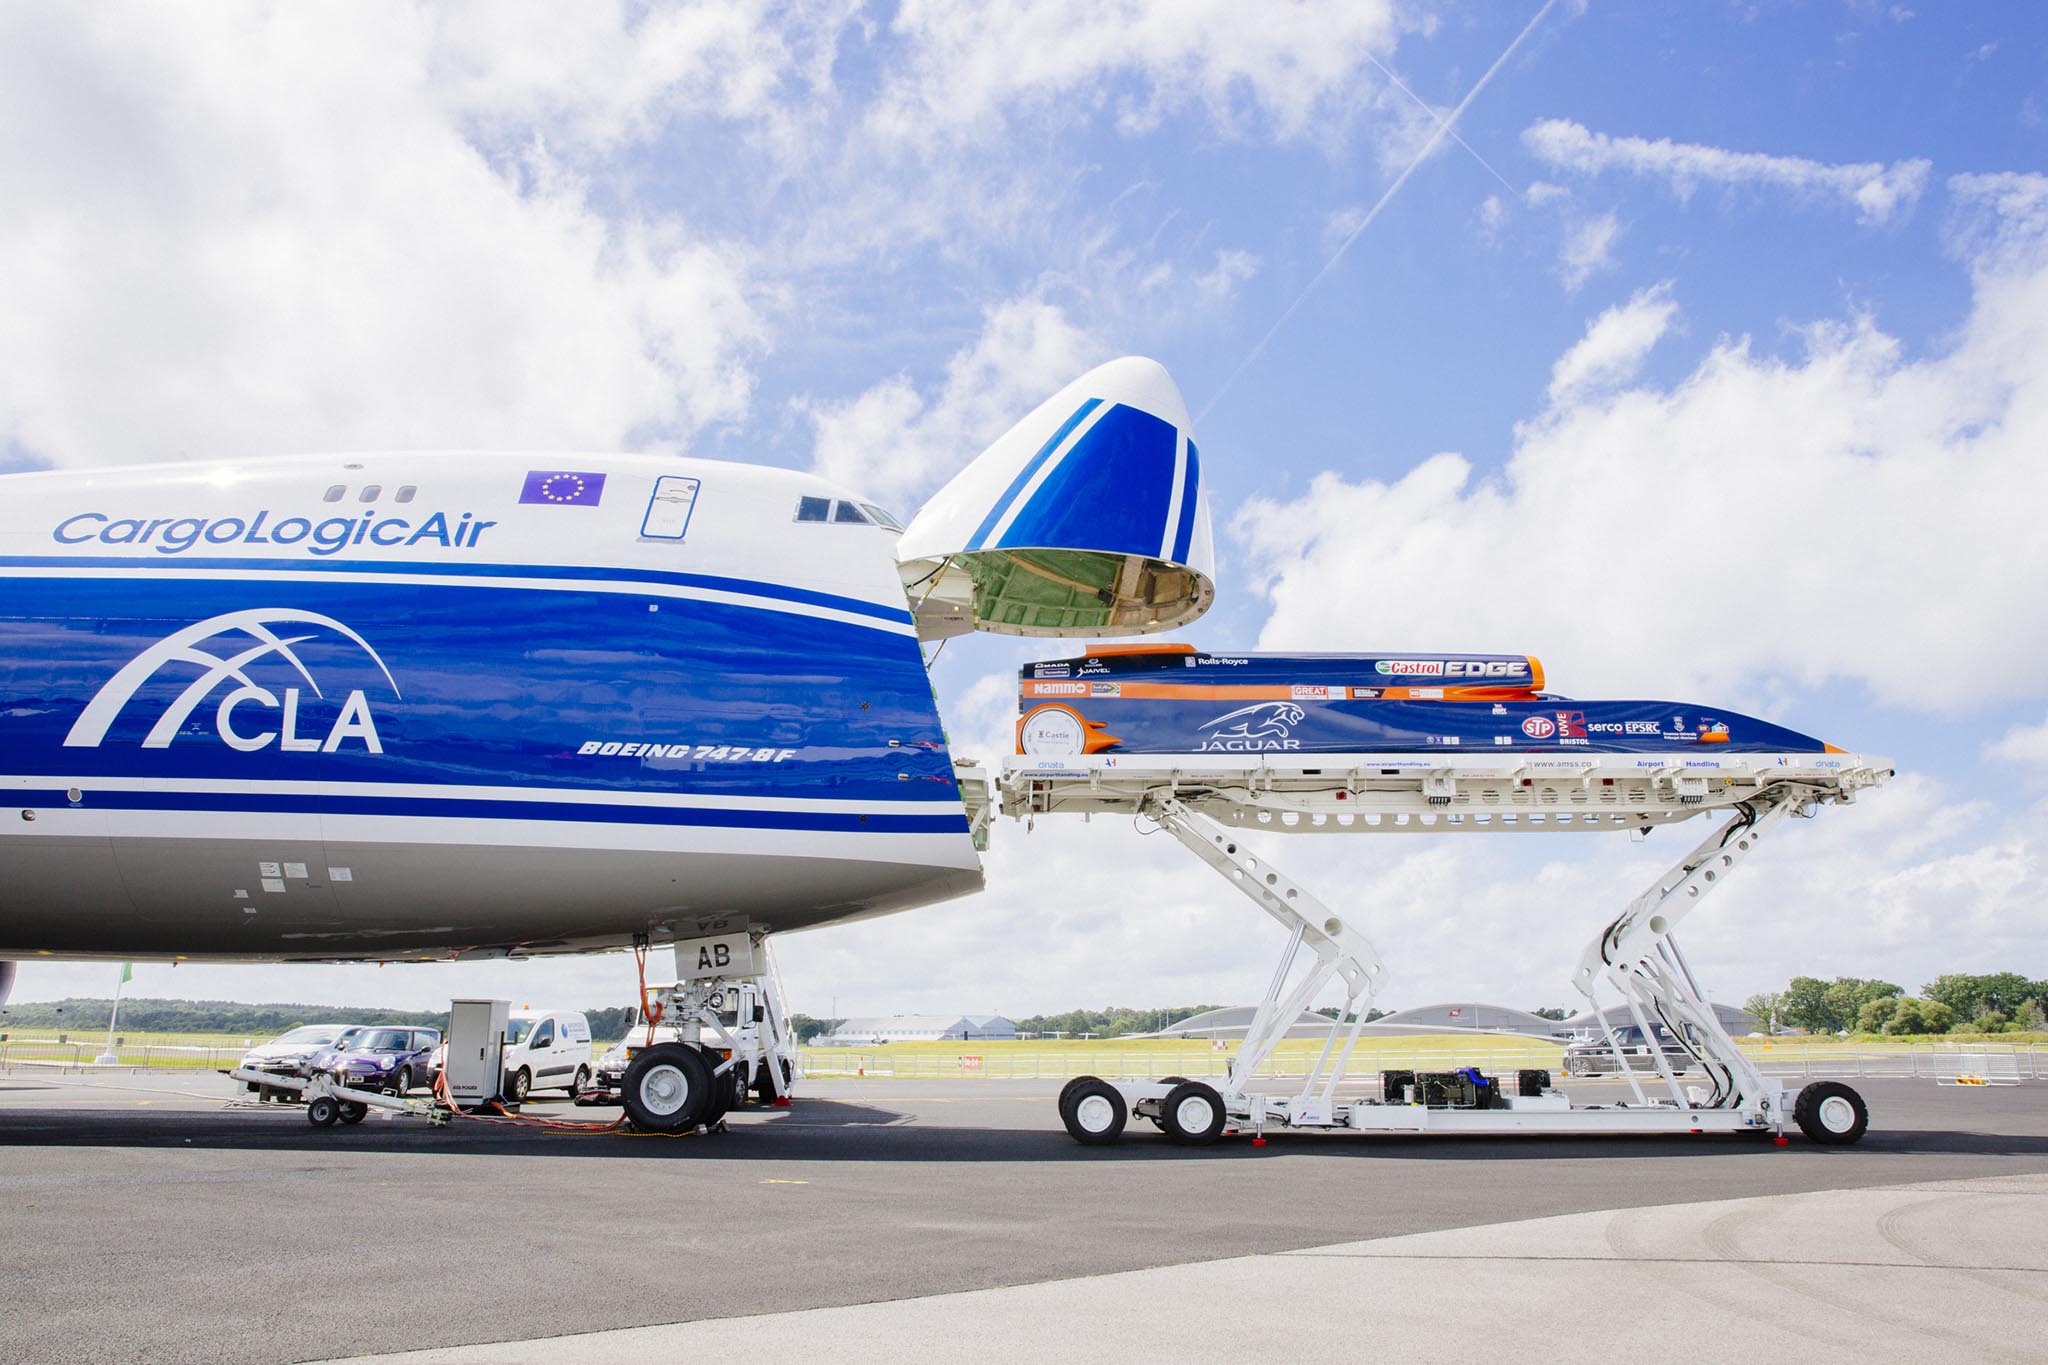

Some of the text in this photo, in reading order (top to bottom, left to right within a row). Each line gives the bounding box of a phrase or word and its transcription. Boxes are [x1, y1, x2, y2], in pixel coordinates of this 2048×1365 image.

[53, 510, 497, 555] CargoLogicAir
[1198, 658, 1249, 667] Rolls-Royce
[1391, 662, 1441, 674] Castrol
[1444, 662, 1528, 677] EDGE
[1034, 683, 1086, 694] Nammo
[1295, 687, 1326, 696] GREAT
[216, 685, 384, 754] CLA
[1556, 713, 1570, 737] UWE
[1525, 719, 1552, 736] STP
[1588, 723, 1623, 732] serco
[1625, 723, 1661, 733] EPSRC
[1045, 731, 1070, 739] Castle
[1192, 740, 1301, 752] JAGUAR
[577, 741, 797, 763] BOEING 747-8F
[1038, 761, 1065, 769] dnata
[1636, 760, 1720, 769] Airport Handling
[1815, 760, 1841, 768] dnata
[698, 943, 731, 970] AB
